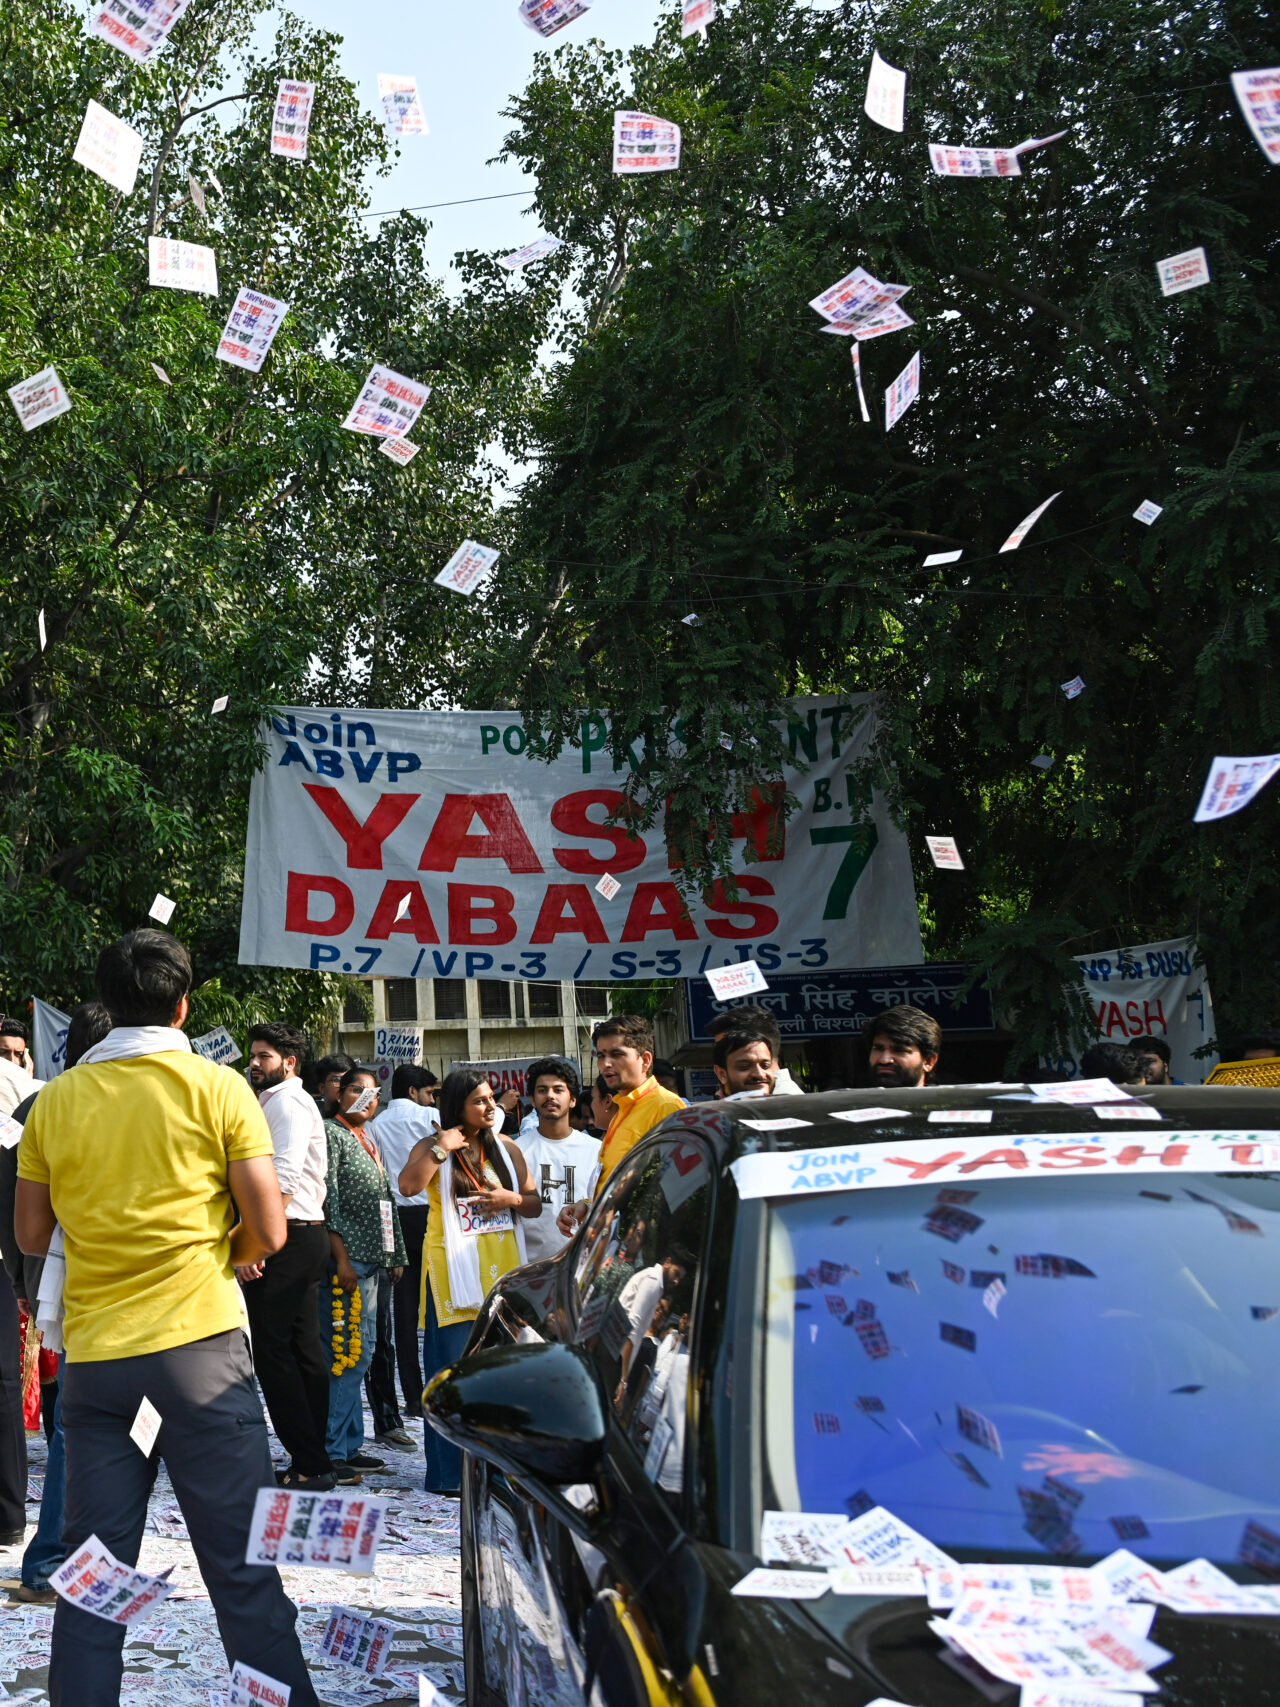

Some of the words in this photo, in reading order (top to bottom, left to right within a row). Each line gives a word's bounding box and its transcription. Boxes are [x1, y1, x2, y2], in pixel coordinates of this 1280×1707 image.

[48, 386, 58, 403] 7
[272, 713, 376, 748] Join
[278, 740, 422, 783] ABVP
[810, 825, 878, 921] 7
[285, 871, 779, 946] DABAAS
[310, 942, 383, 970] P.7
[1146, 951, 1192, 978] DUSU
[714, 972, 744, 984] YASH
[746, 972, 755, 982] 7
[802, 984, 856, 1012] सिंह
[378, 1029, 386, 1055] 3
[388, 1034, 420, 1046] RIYAA
[788, 1151, 862, 1171] JOIN
[790, 1166, 878, 1190] ABVP
[884, 1144, 1190, 1180] YASH
[458, 1204, 472, 1232] 3
